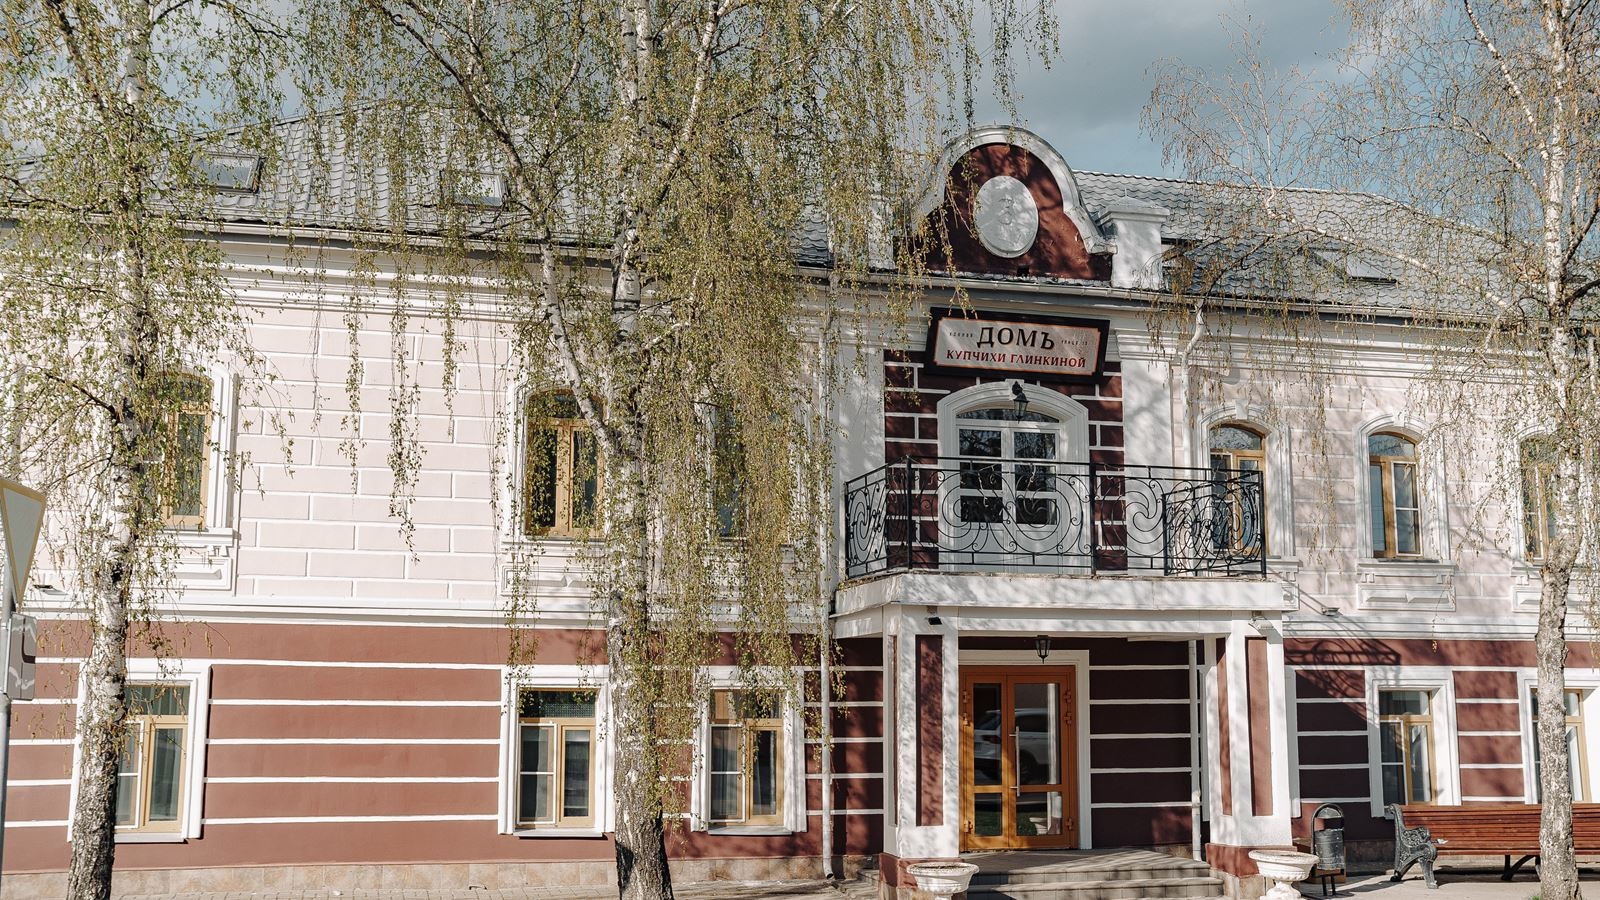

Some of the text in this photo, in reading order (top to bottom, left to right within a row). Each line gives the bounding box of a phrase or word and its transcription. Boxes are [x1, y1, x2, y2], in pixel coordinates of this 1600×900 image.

[976, 327, 1055, 350] ДОМЪ
[946, 350, 1086, 368] КУПЧИХИ ГЛИНКИНОЙ
